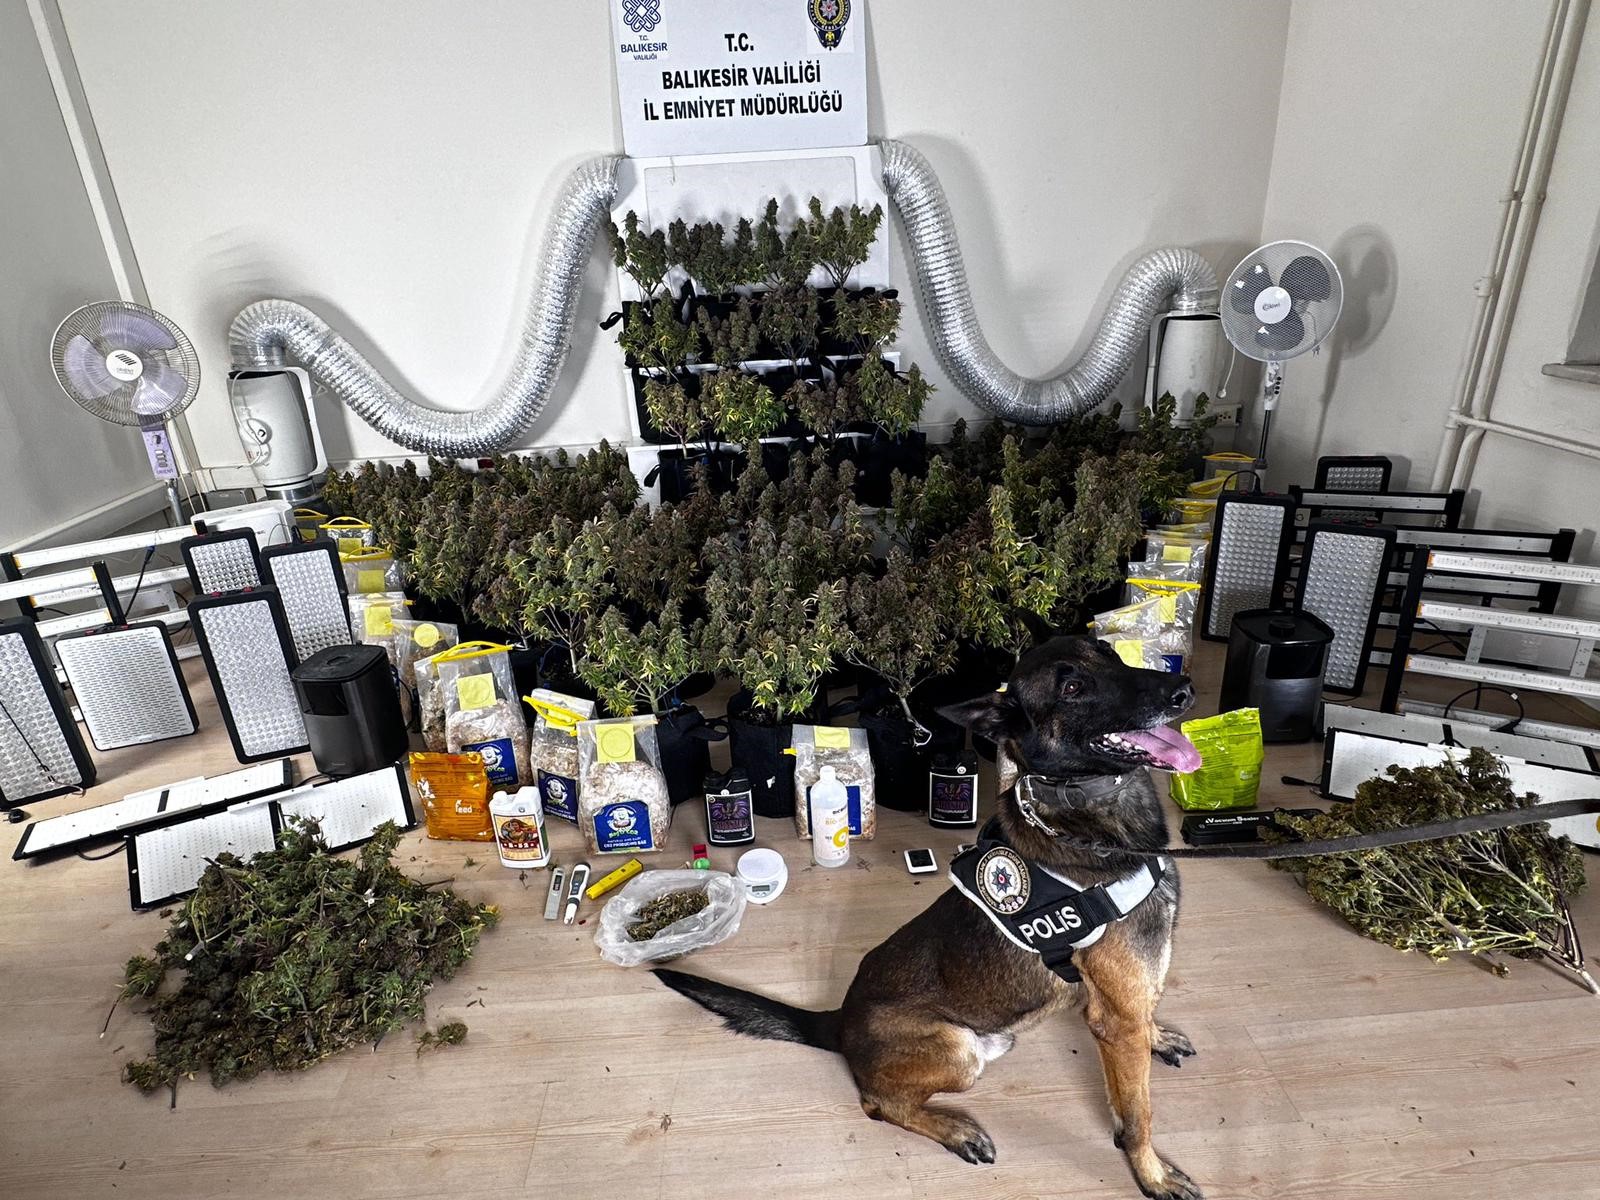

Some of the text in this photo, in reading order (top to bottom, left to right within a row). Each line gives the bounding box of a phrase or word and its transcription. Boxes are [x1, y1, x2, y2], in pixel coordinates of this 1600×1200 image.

[620, 42, 668, 53] BALIKESİR
[724, 32, 755, 52] T.C.
[662, 60, 821, 90] BALIKESİR VALİLİĞİ
[643, 90, 843, 121] İL EMNİYET MÜDÜRLÜĞÜ
[1018, 905, 1083, 945] POLİS
